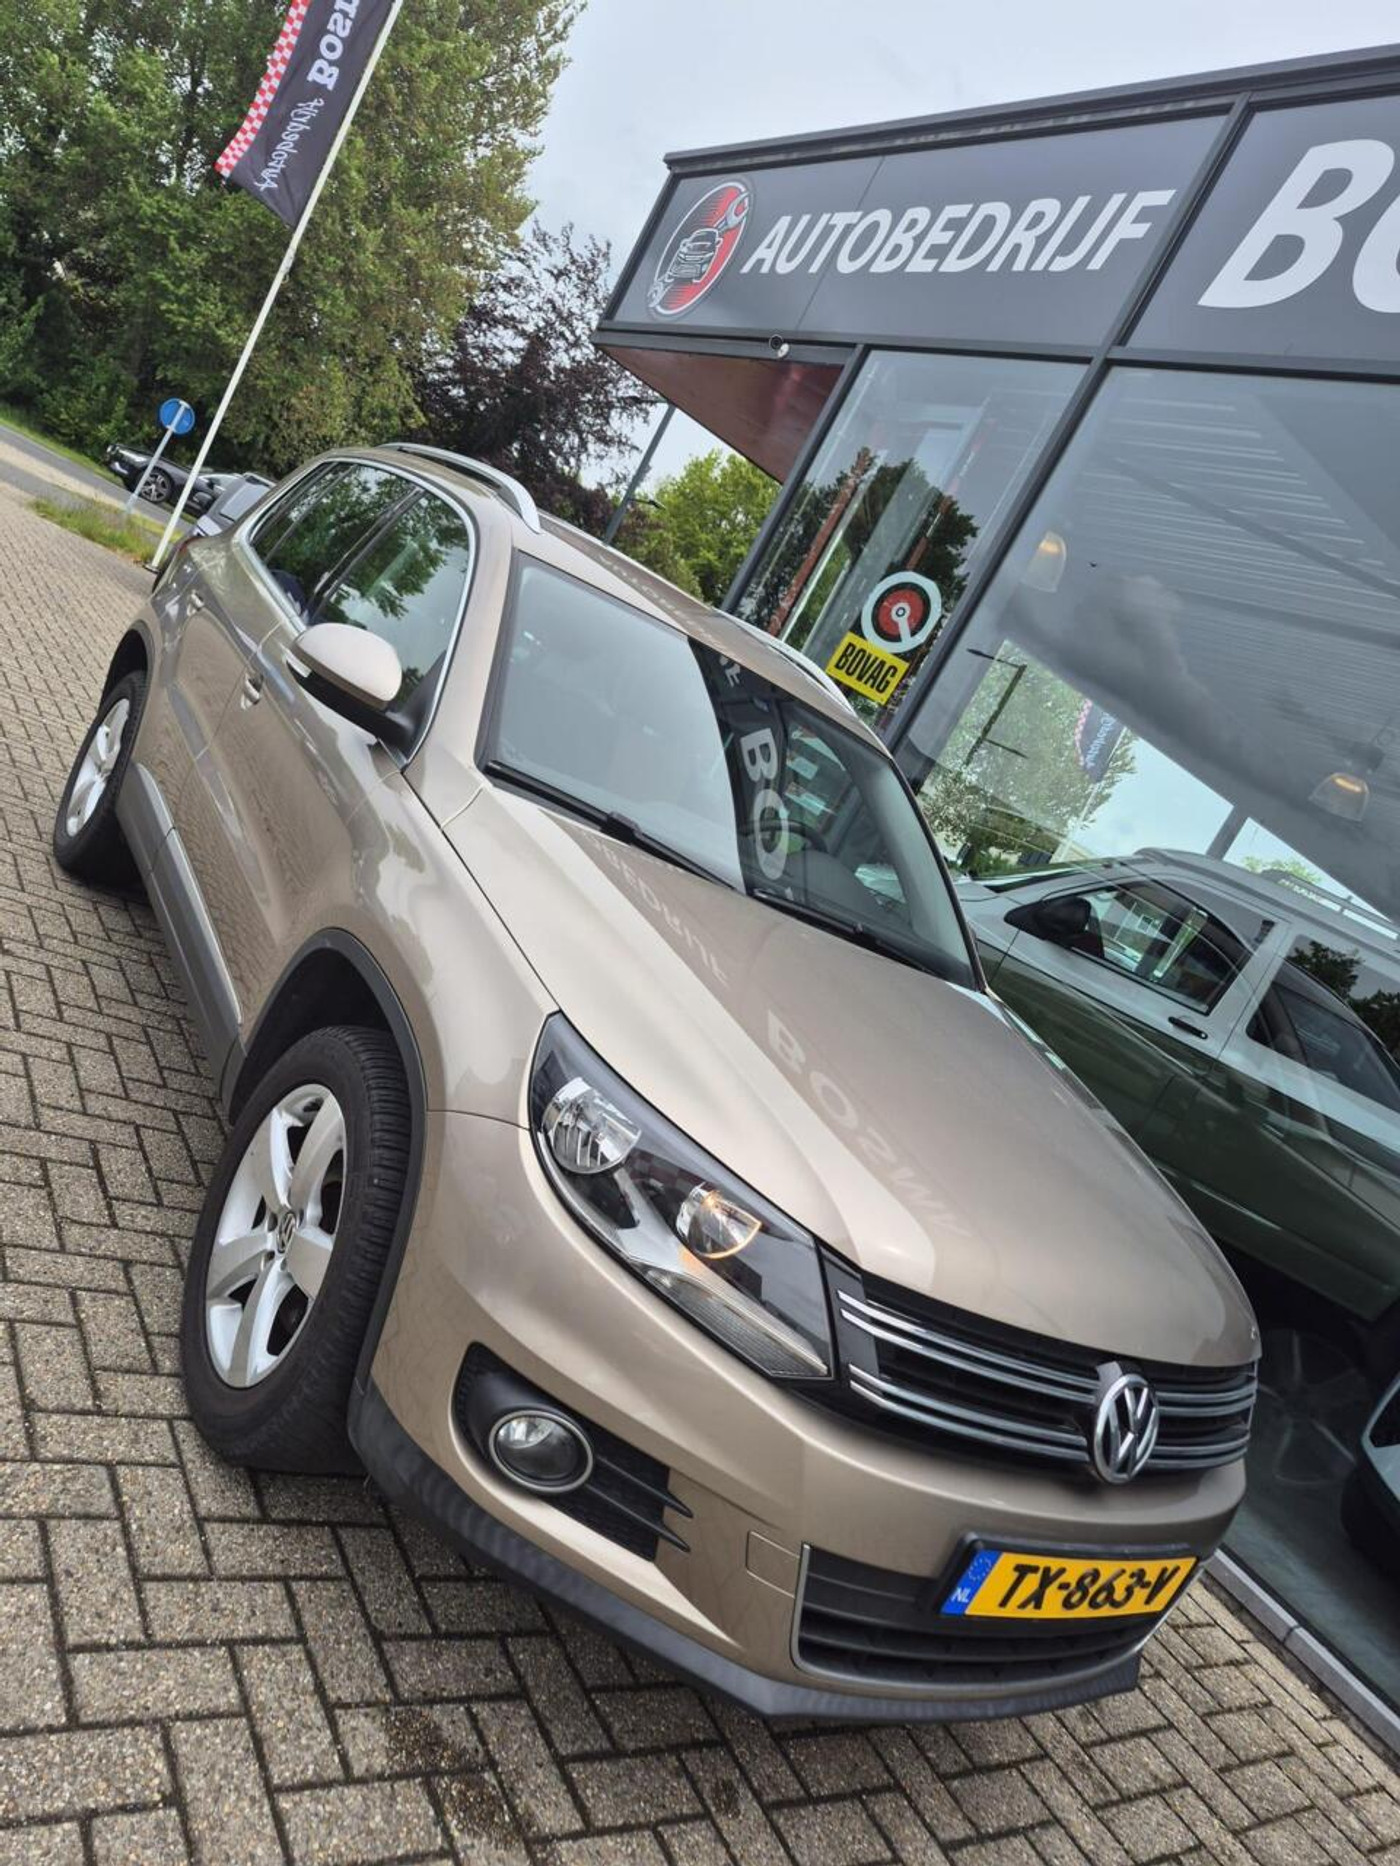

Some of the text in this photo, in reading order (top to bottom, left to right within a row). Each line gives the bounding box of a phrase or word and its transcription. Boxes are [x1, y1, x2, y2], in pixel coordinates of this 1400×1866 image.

[741, 189, 1178, 275] AUTOBEDRIJF
[834, 642, 898, 695] BOVAG
[950, 1562, 1181, 1610] NL TX-863-V
